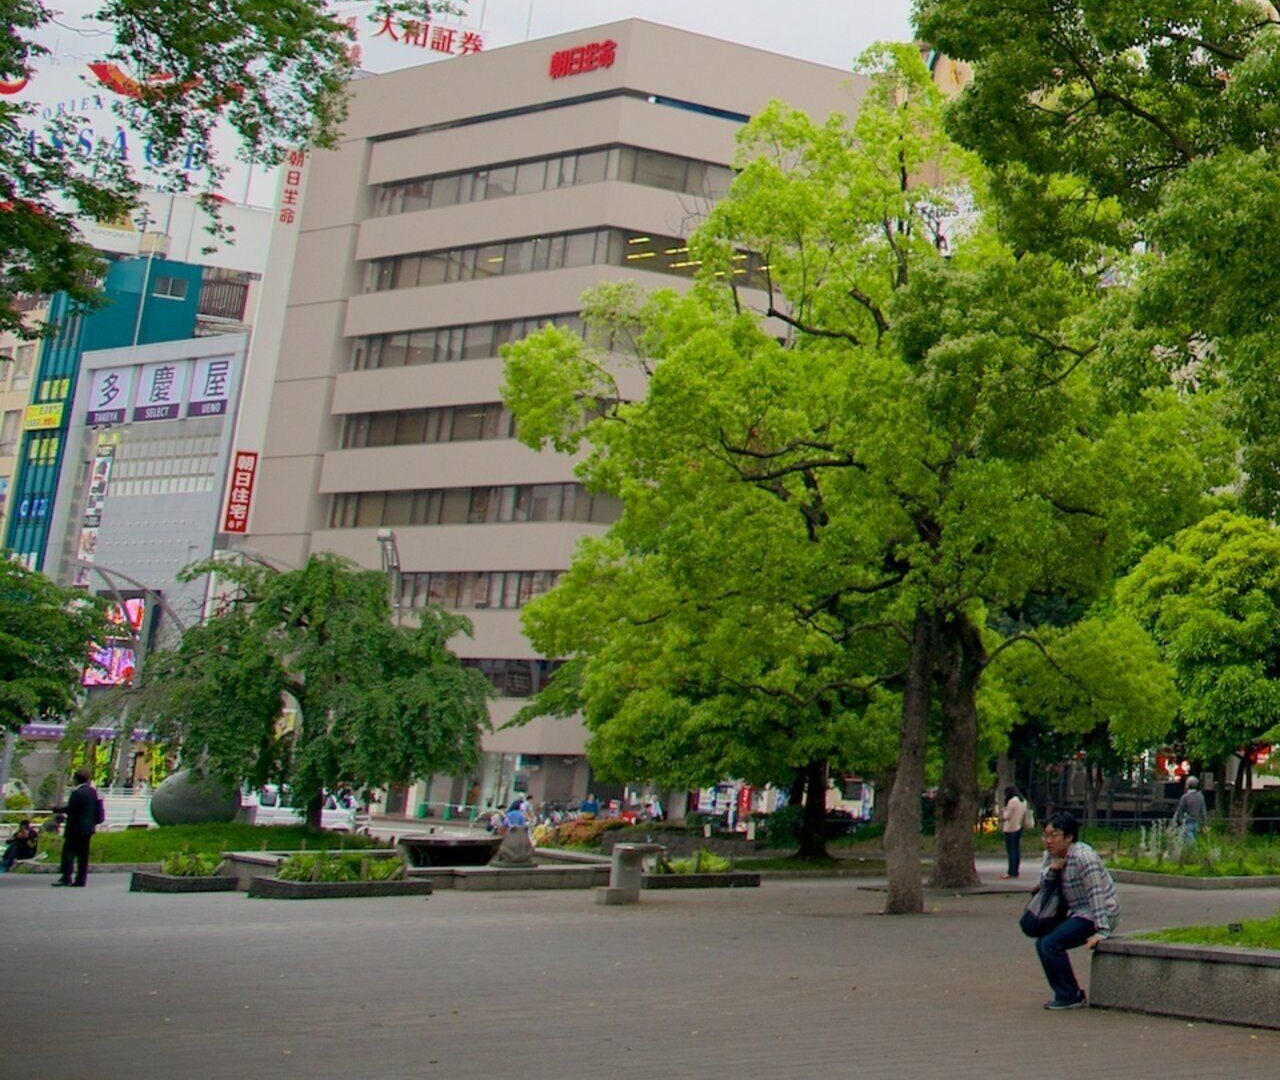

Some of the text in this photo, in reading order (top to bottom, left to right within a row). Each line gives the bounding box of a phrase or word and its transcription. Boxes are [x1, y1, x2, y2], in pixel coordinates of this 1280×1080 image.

[371, 15, 485, 56] 大和証券
[549, 39, 617, 79] 朝日生命
[279, 151, 305, 224] 朝日生命
[99, 360, 229, 408] 多慶屋
[94, 402, 221, 423] TAKEYA SELECT UENO
